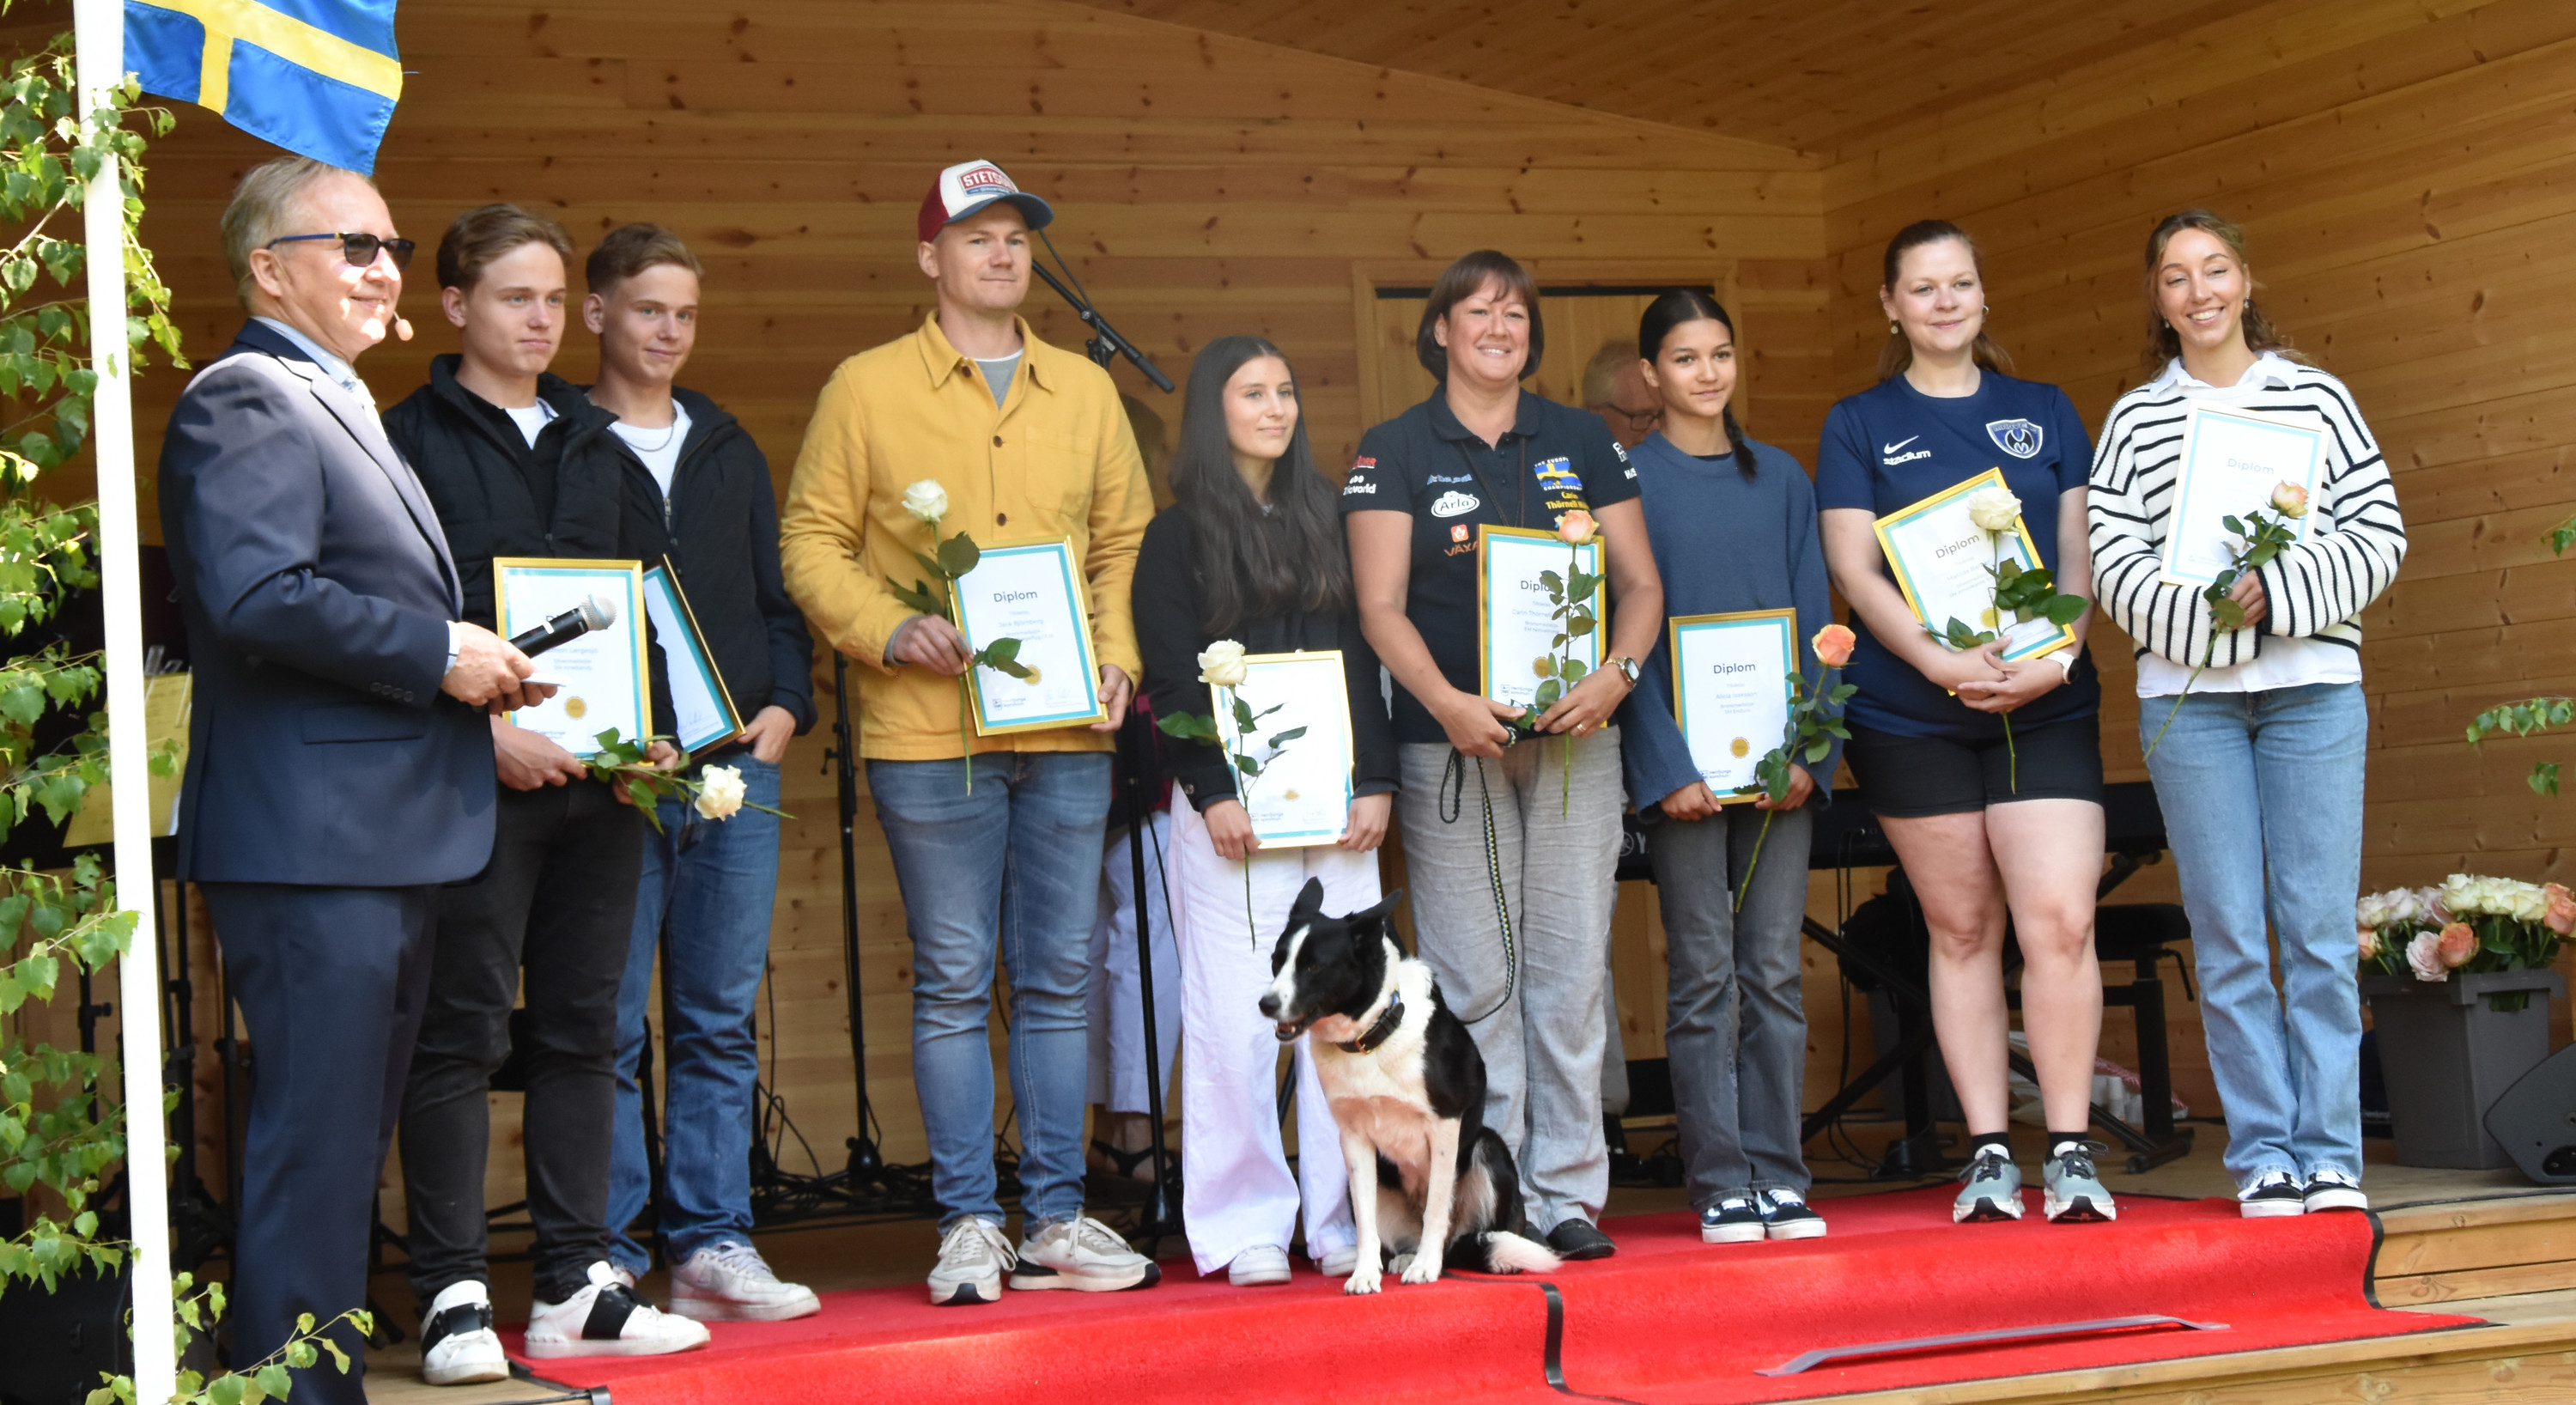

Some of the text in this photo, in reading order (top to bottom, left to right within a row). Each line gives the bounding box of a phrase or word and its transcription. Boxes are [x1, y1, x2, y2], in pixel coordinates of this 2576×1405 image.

[2227, 458, 2275, 475] Diplom
[1440, 498, 1469, 513] Arla
[1935, 534, 1980, 558] Diplom
[1520, 580, 1551, 593] Diplo
[993, 591, 1038, 603] Diplom
[1713, 662, 1756, 676] Diplom
